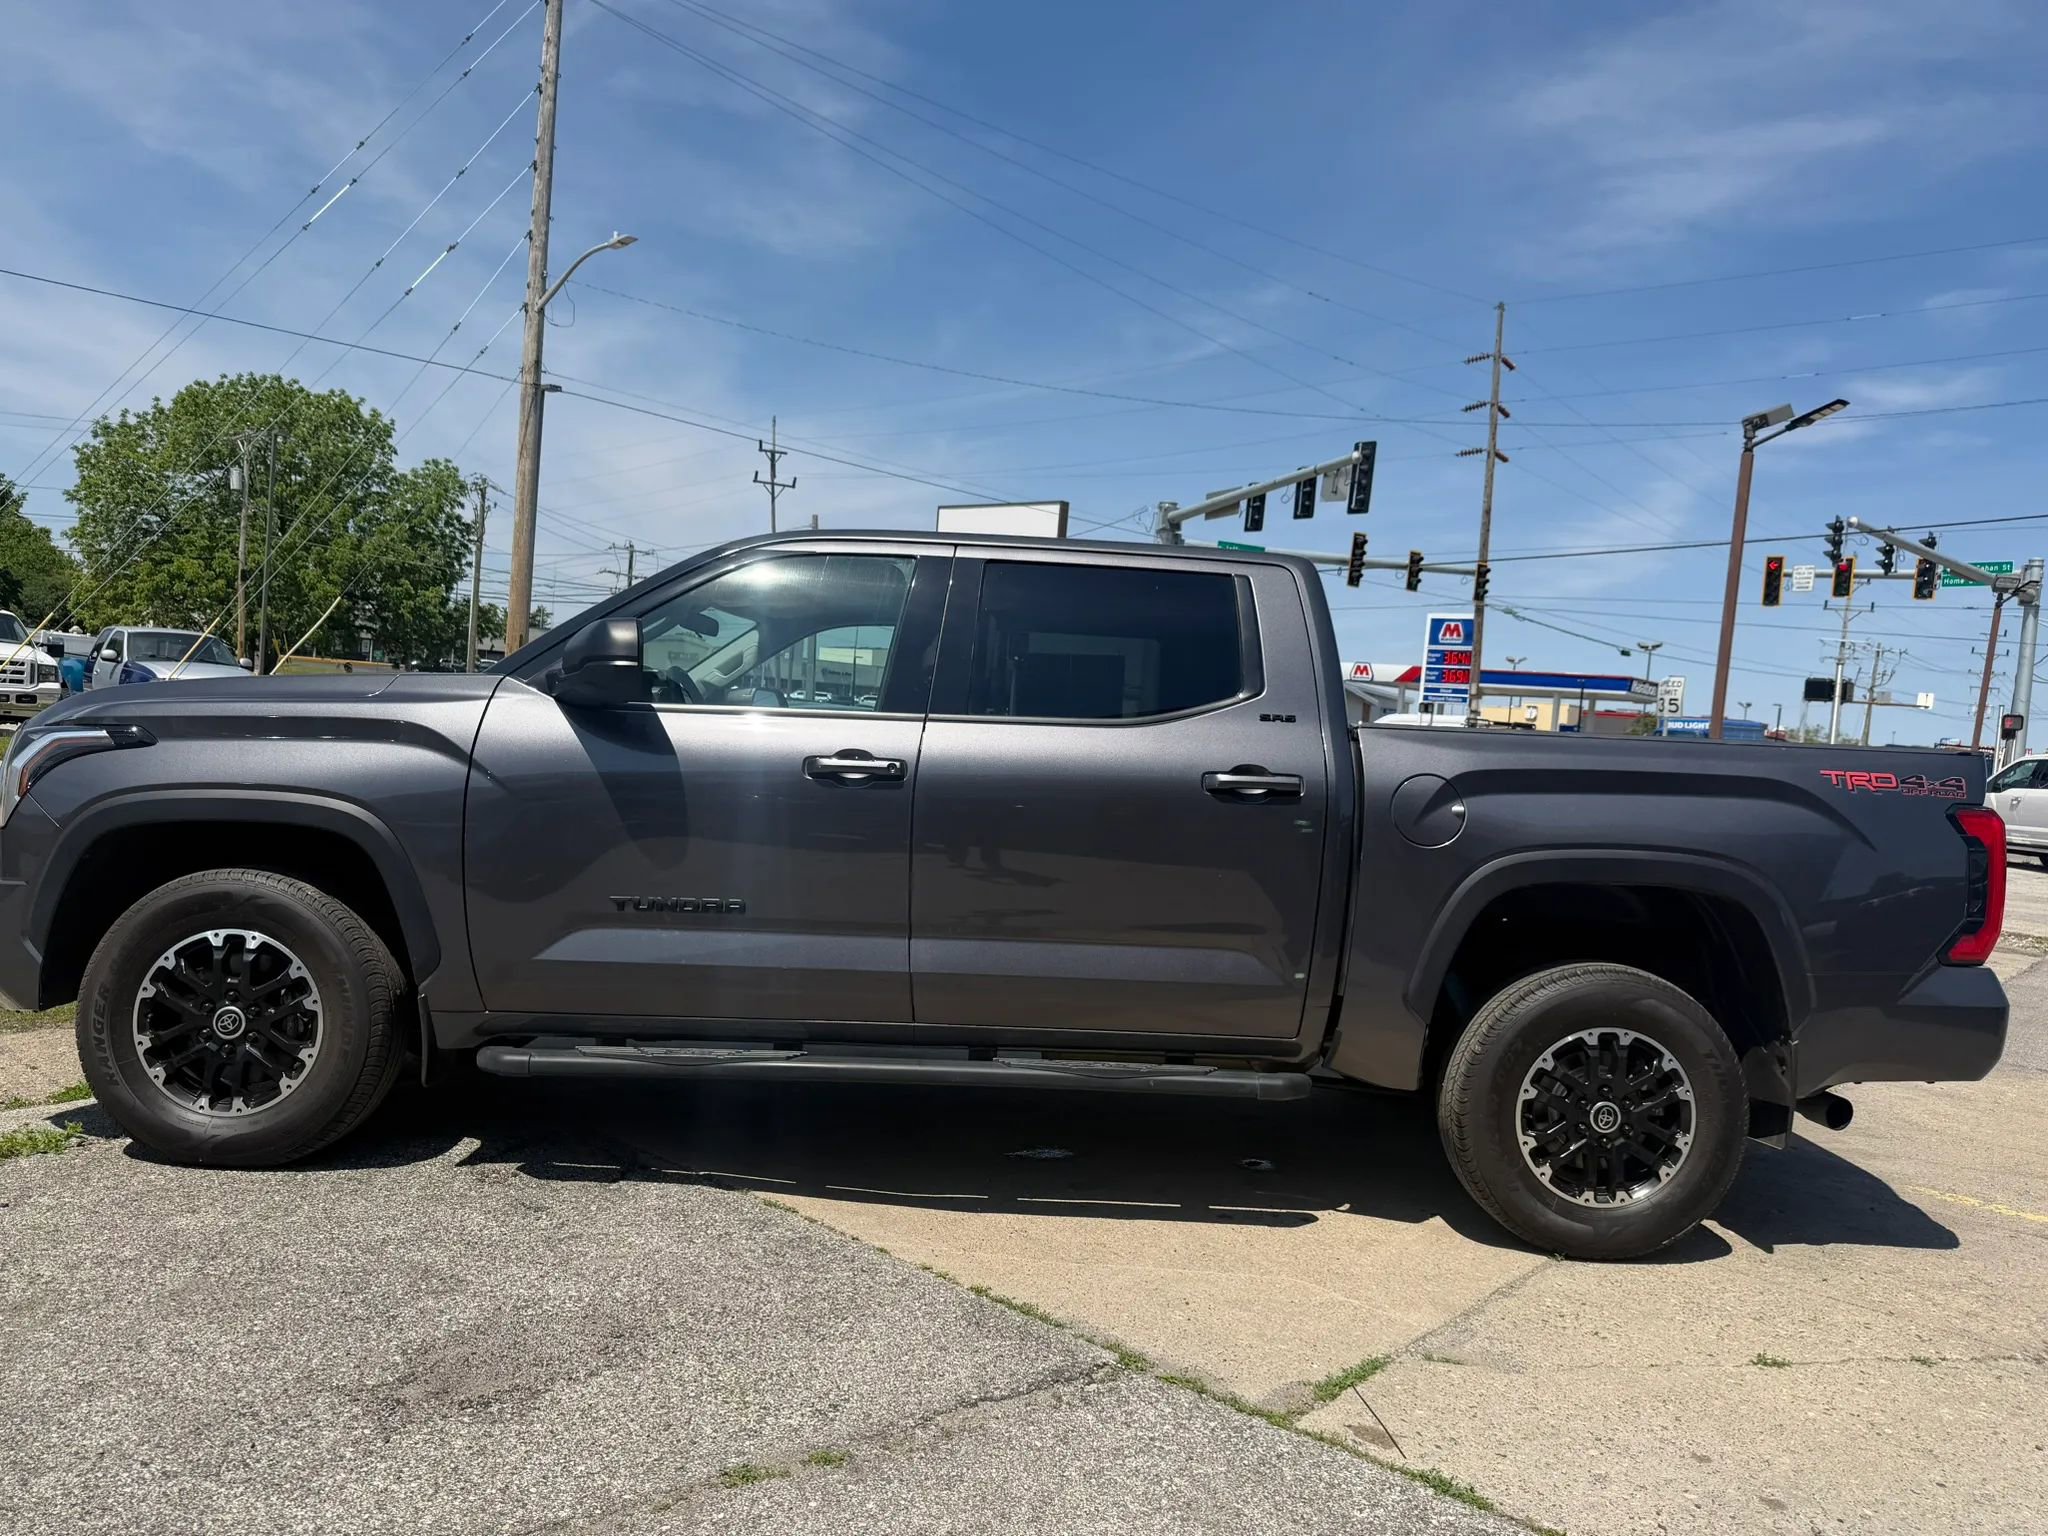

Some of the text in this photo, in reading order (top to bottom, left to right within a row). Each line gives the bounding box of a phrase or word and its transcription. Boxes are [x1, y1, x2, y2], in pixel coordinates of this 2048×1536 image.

[1943, 577, 1965, 585] Home
[1441, 623, 1462, 638] M
[1353, 664, 1370, 676] M
[1659, 688, 1679, 697] LIMIT
[1658, 697, 1680, 713] 35
[1259, 713, 1297, 723] SR5
[1667, 721, 1710, 730] BUD LIGHT
[1819, 769, 1899, 795] TRD
[608, 895, 747, 914] TUNDRA
